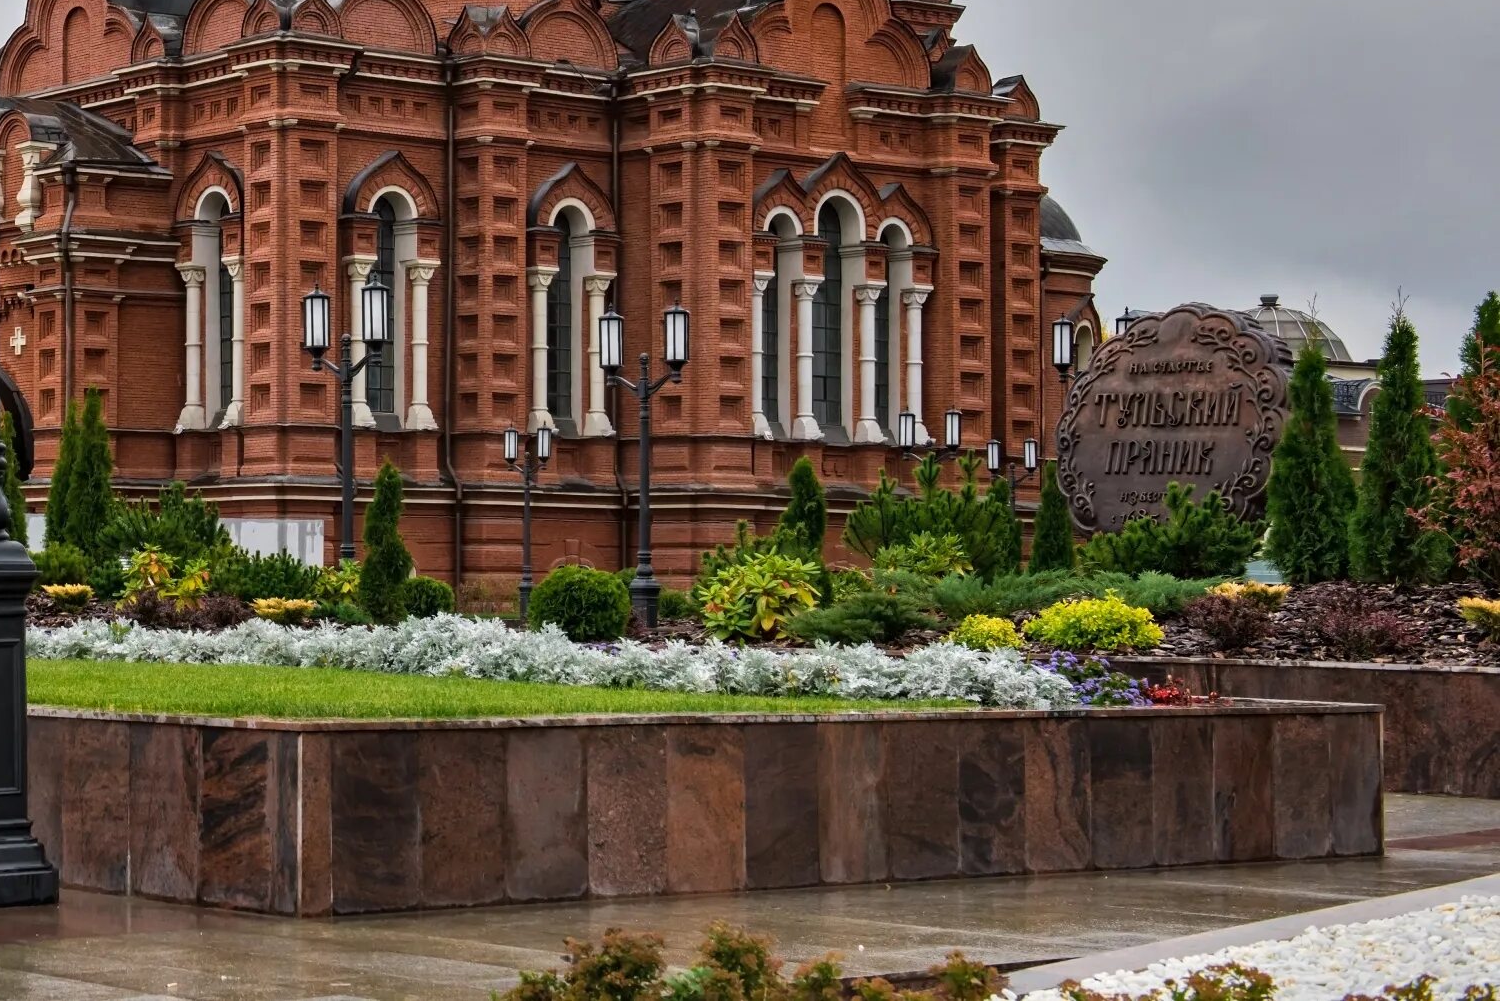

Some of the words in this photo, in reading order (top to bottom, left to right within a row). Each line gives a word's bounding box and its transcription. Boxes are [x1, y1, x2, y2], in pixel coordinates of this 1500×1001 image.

[1128, 361, 1148, 375] НА
[1153, 359, 1214, 374] СЧАСТЬЕ
[1094, 382, 1242, 427] ТУЛЬСКИЙ
[1104, 439, 1216, 475] ПРЯНИК
[1119, 490, 1168, 506] ИЗВЕСТ
